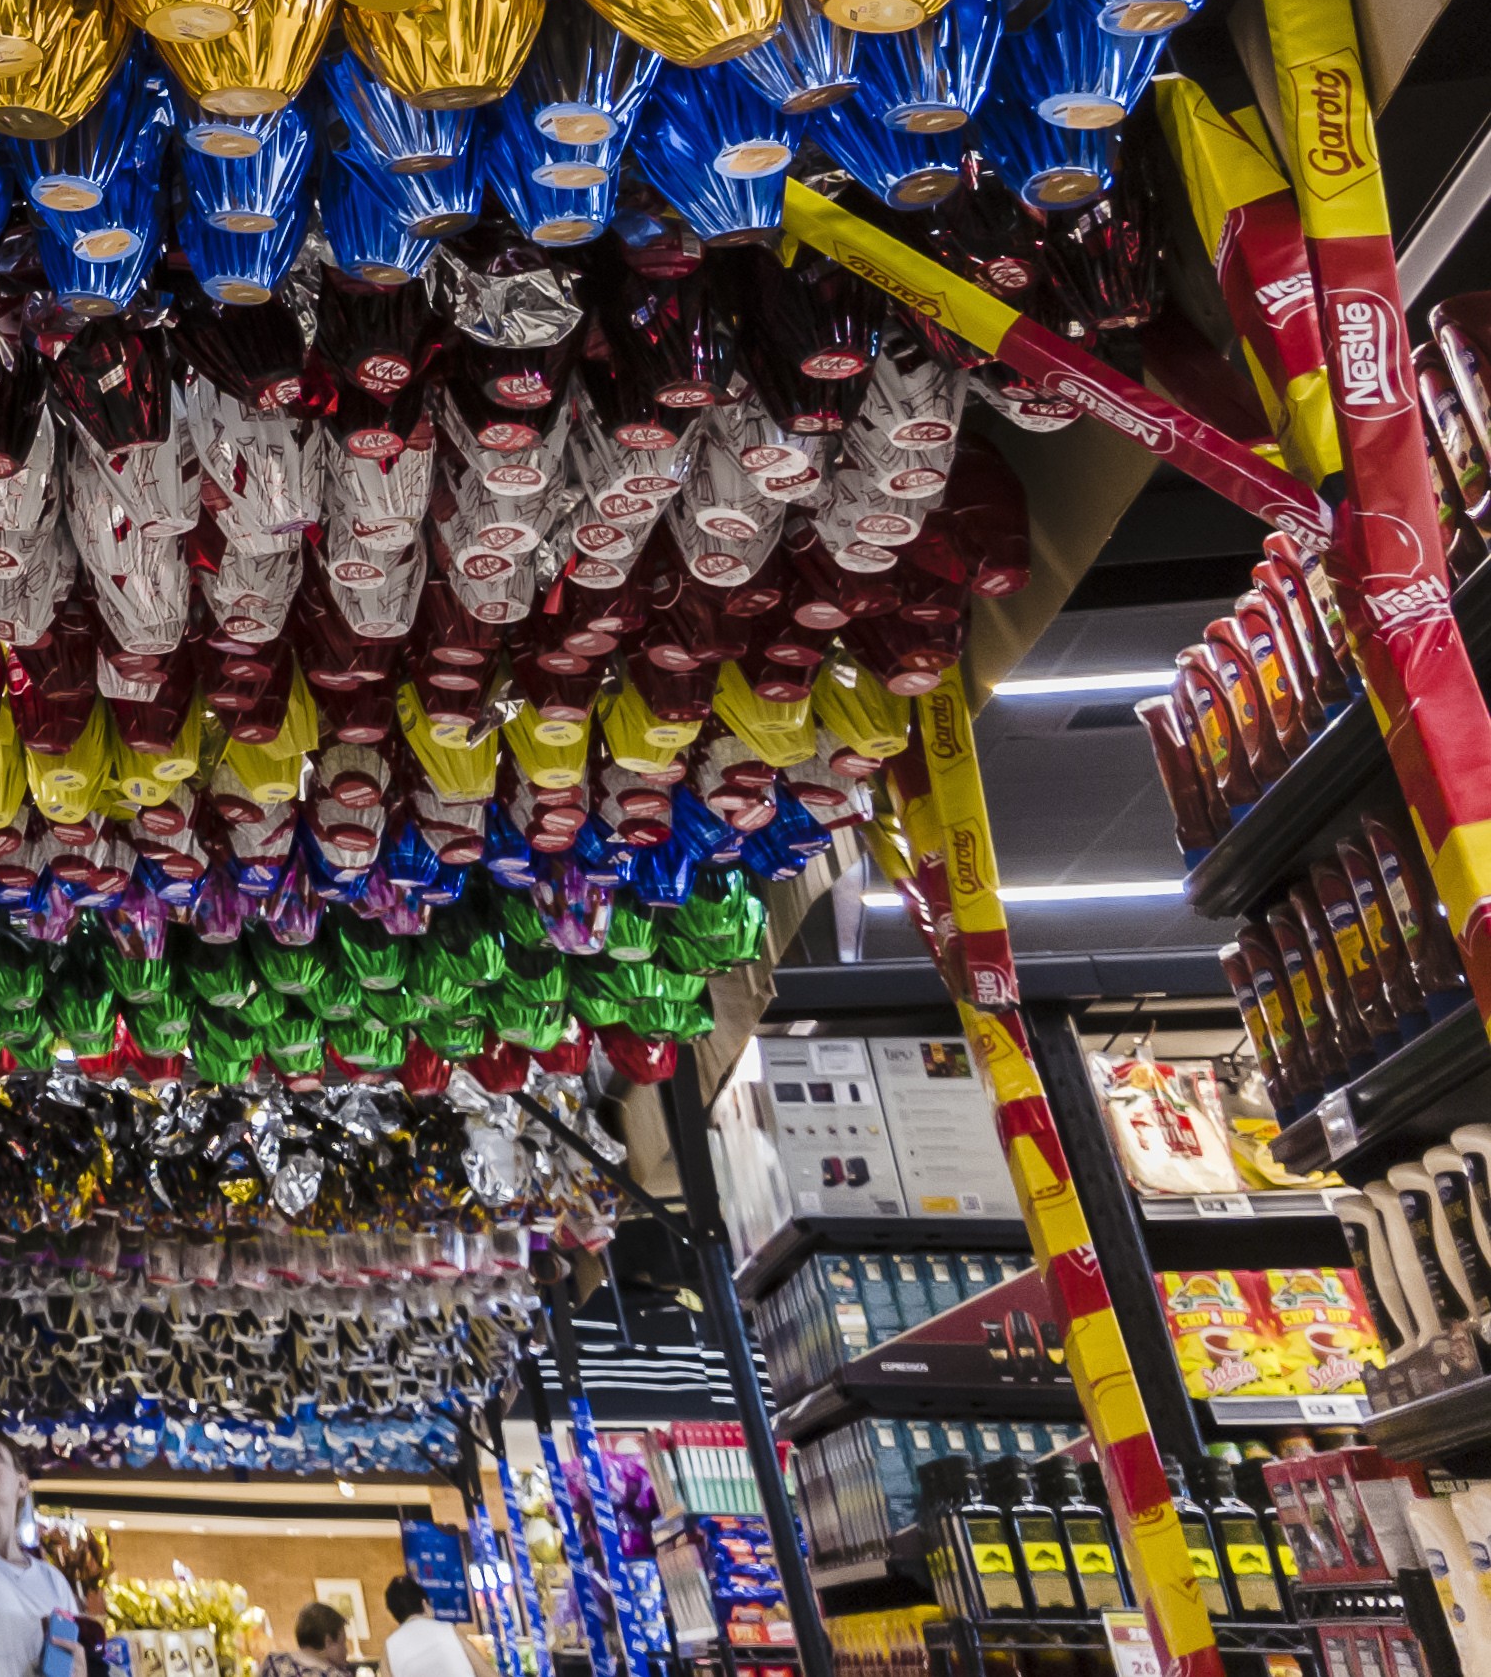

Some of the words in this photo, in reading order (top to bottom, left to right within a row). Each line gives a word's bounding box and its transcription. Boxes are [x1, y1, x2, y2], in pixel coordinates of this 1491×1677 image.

[1308, 68, 1351, 177] Garoto
[848, 255, 942, 319] Garoto
[1337, 302, 1381, 406] Nestlé
[1058, 381, 1160, 446] Nestlé
[933, 694, 957, 759] Garoto
[954, 829, 978, 895] Garoto
[1176, 1311, 1210, 1327] CHIP
[1222, 1311, 1247, 1328] DIP
[1280, 1310, 1315, 1325] CHIP
[1327, 1309, 1352, 1326] DIP
[1201, 1358, 1258, 1392] Salsa
[1305, 1358, 1362, 1391] Salsa
